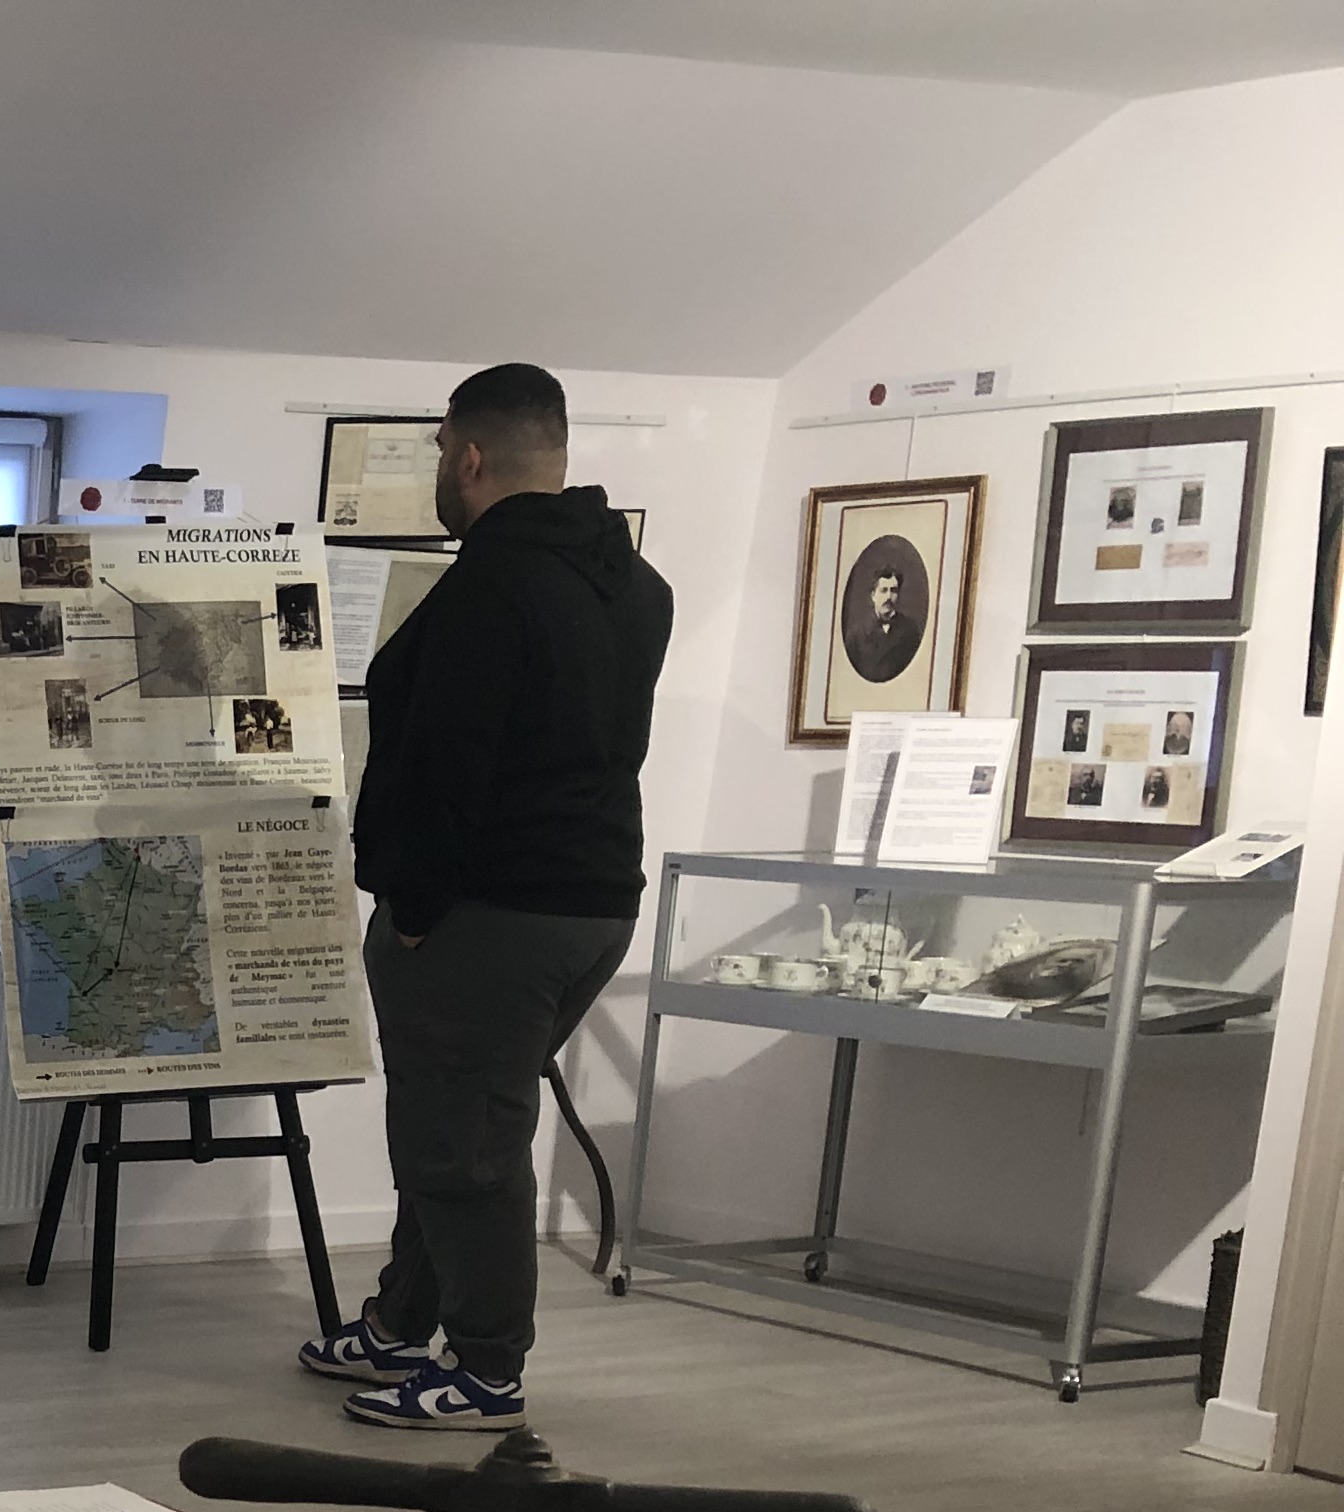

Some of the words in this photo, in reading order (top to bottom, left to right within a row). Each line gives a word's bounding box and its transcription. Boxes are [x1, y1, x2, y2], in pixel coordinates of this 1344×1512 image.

[166, 528, 272, 544] MIGRATIONS
[137, 550, 160, 564] EN
[237, 821, 253, 833] LE
[256, 818, 310, 832] NÉGOCE
[284, 848, 303, 858] Jean
[234, 960, 279, 970] marchands
[280, 959, 291, 968] de
[293, 959, 310, 967] vins
[312, 957, 323, 966] du
[324, 957, 344, 968] pays
[229, 973, 240, 983] de
[251, 972, 287, 983] Meymac
